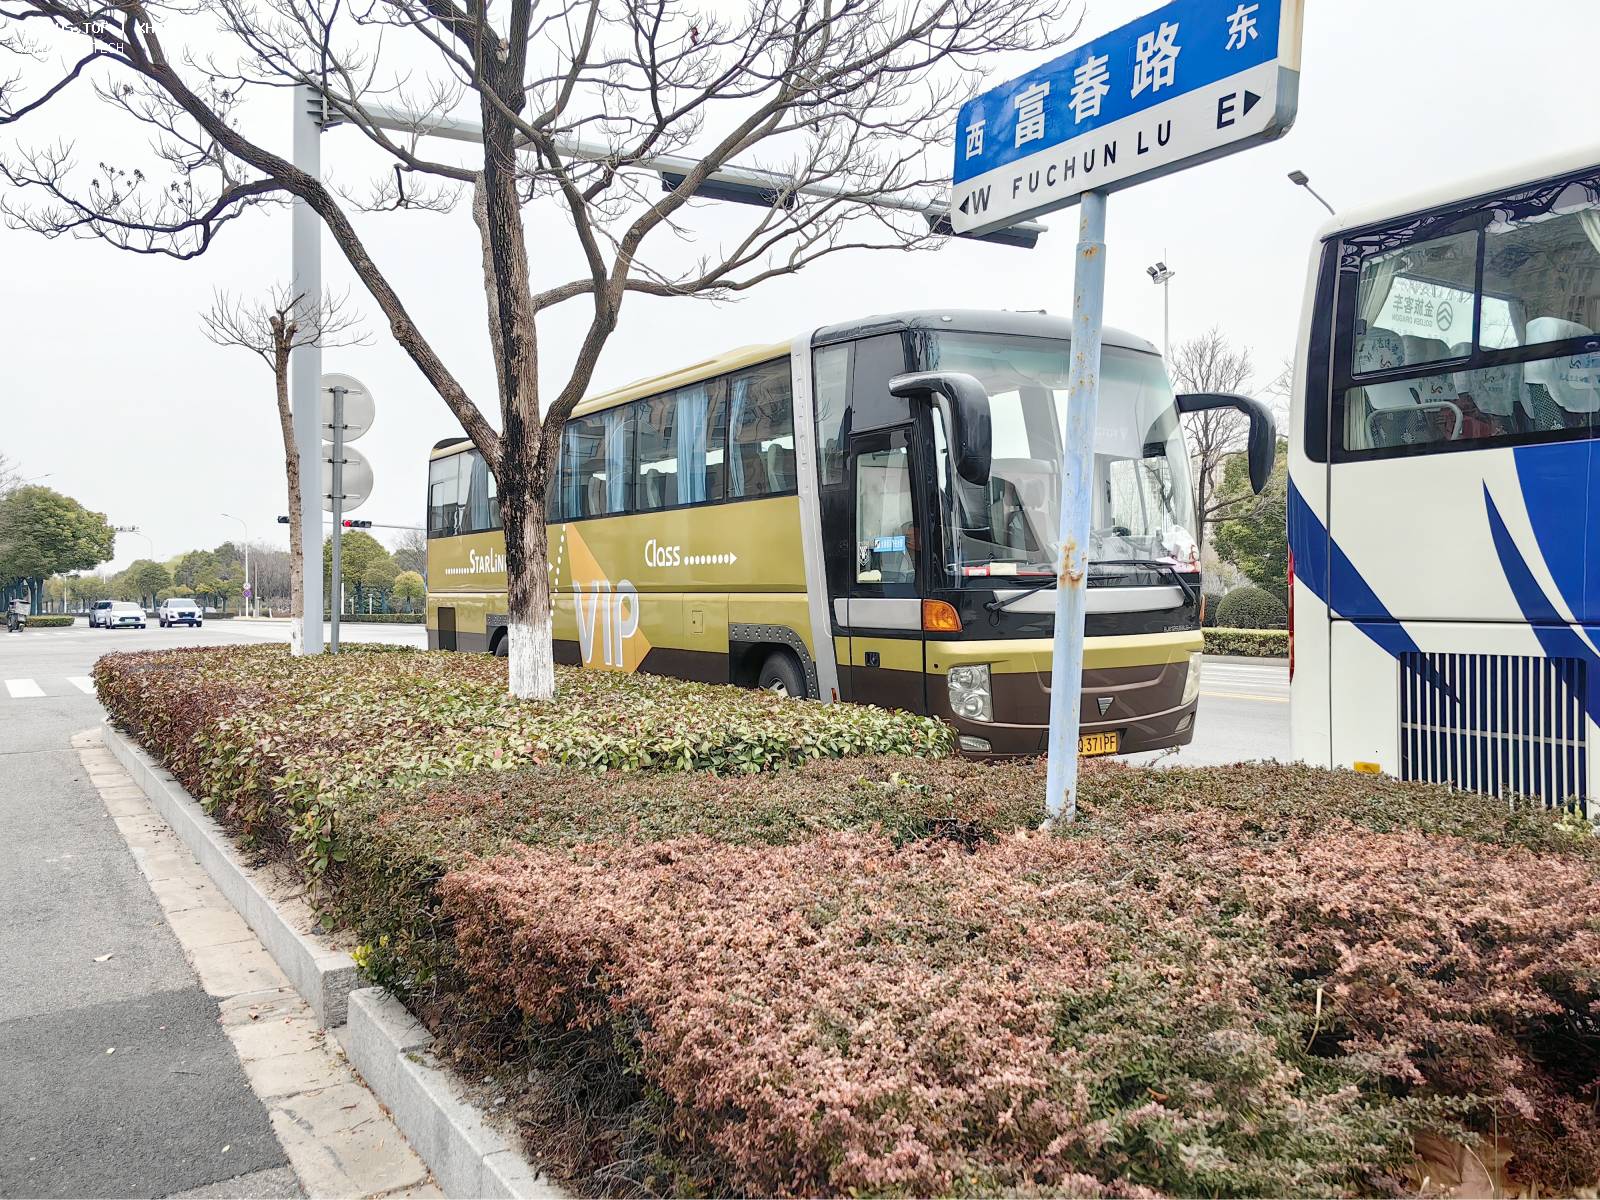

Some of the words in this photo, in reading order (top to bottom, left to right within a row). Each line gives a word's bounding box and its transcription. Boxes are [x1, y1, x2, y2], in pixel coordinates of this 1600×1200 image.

[965, 119, 986, 160] 西
[1014, 21, 1182, 149] 富春路
[1225, 3, 1260, 50] 东
[972, 185, 991, 214] W
[1013, 141, 1116, 199] FUCHUN
[1137, 120, 1171, 155] LU
[1217, 92, 1237, 129] E
[644, 538, 681, 567] Class
[572, 579, 640, 668] VIP
